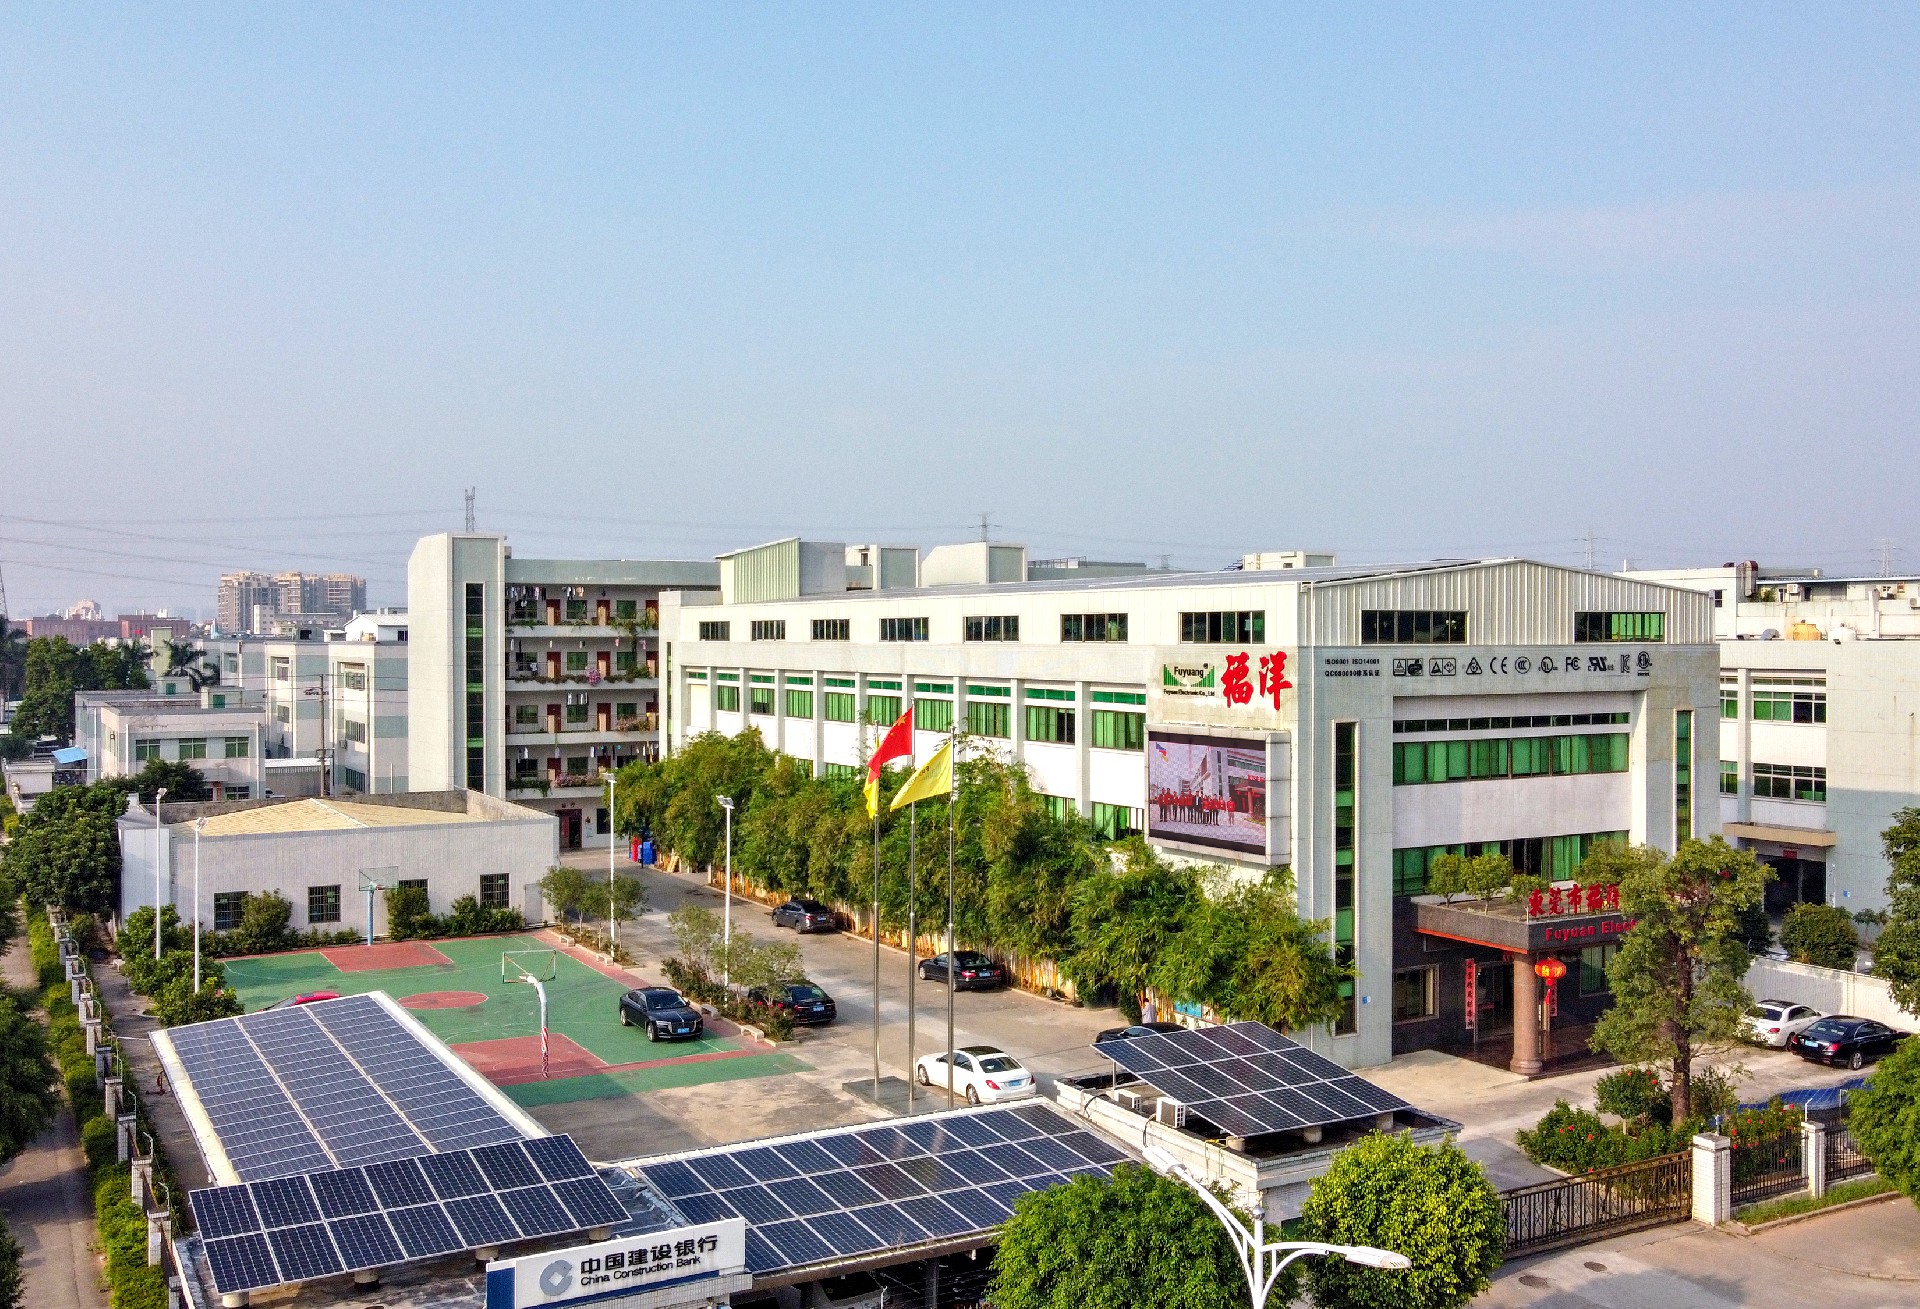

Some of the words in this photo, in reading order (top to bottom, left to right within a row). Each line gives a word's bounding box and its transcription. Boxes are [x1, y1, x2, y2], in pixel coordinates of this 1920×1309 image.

[1174, 666, 1204, 678] Fuyuang
[1545, 925, 1596, 943] Fuyuan
[581, 1235, 718, 1274] 中国建设银行
[581, 1274, 610, 1286] China
[613, 1261, 674, 1280] Construction
[676, 1256, 701, 1268] Bank
